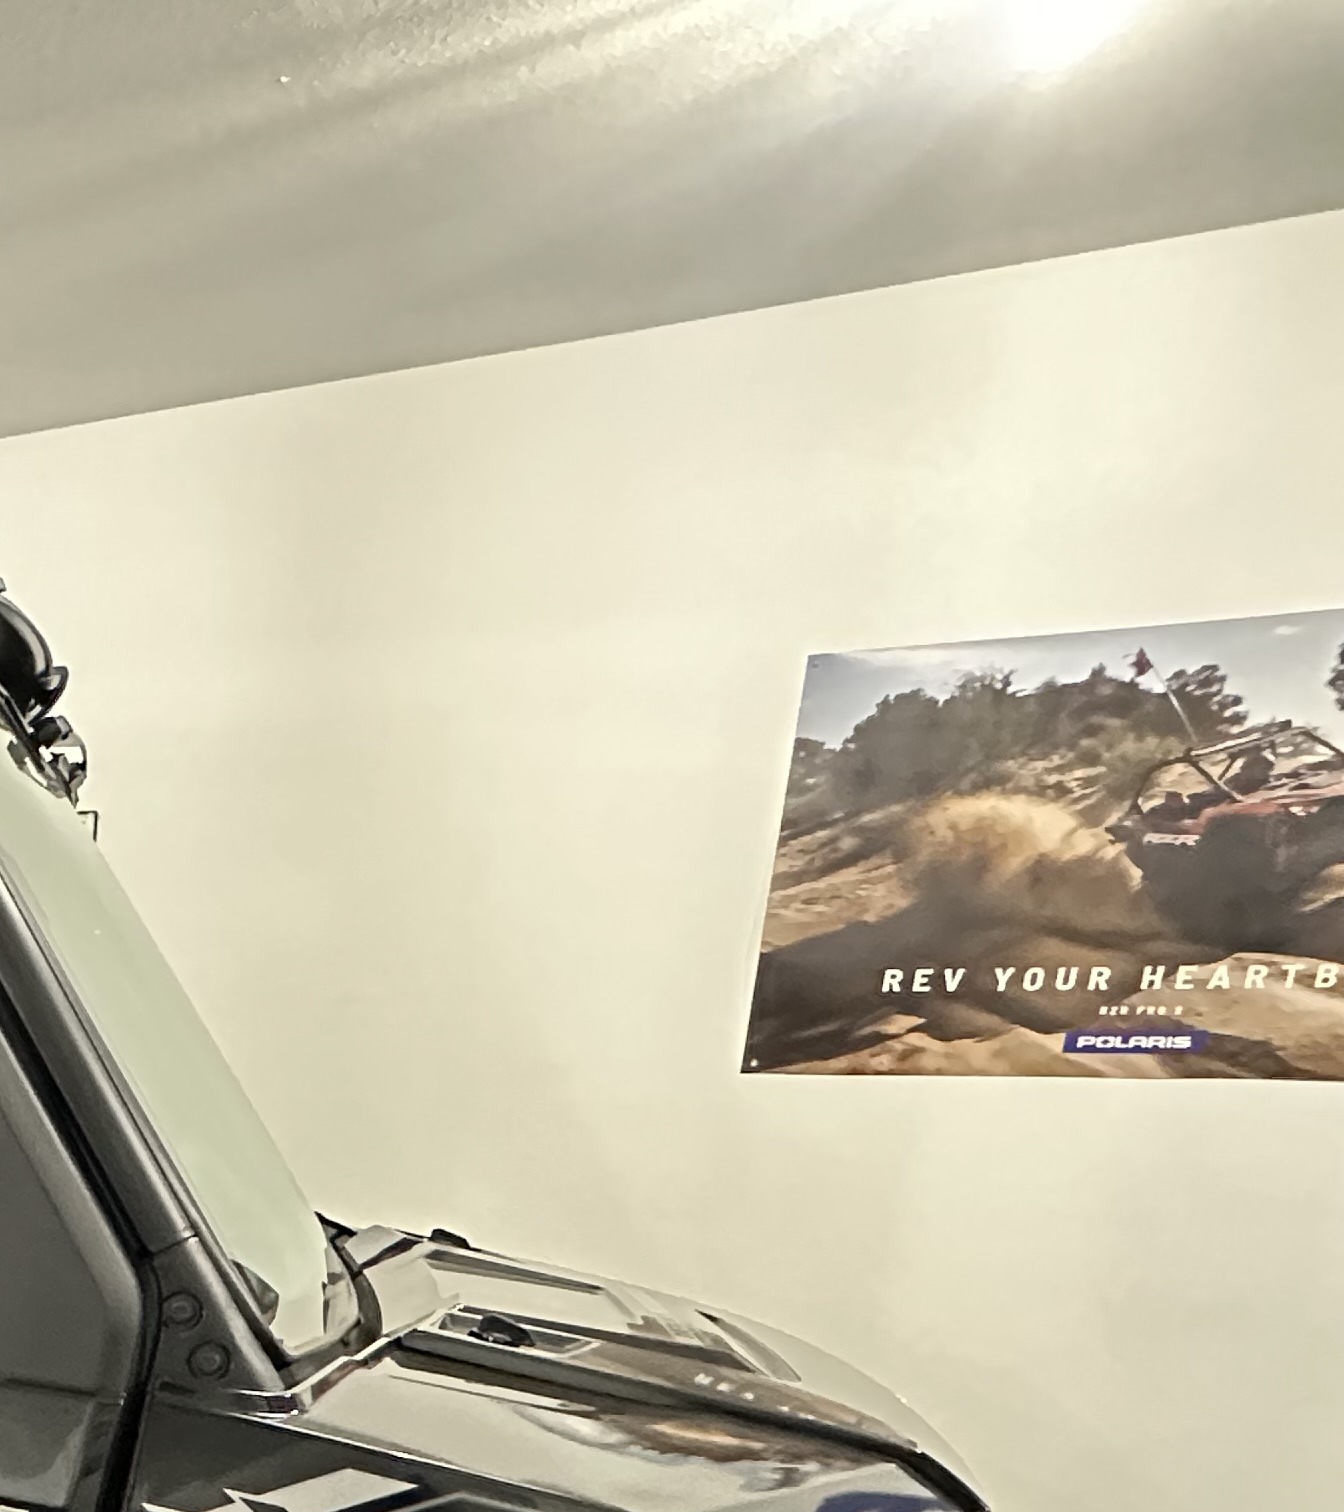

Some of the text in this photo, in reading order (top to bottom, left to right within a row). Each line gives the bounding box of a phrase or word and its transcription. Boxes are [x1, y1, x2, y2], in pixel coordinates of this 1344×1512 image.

[881, 963, 1340, 992] REV YOUR HEARTB
[1076, 1035, 1192, 1050] POLARIS
